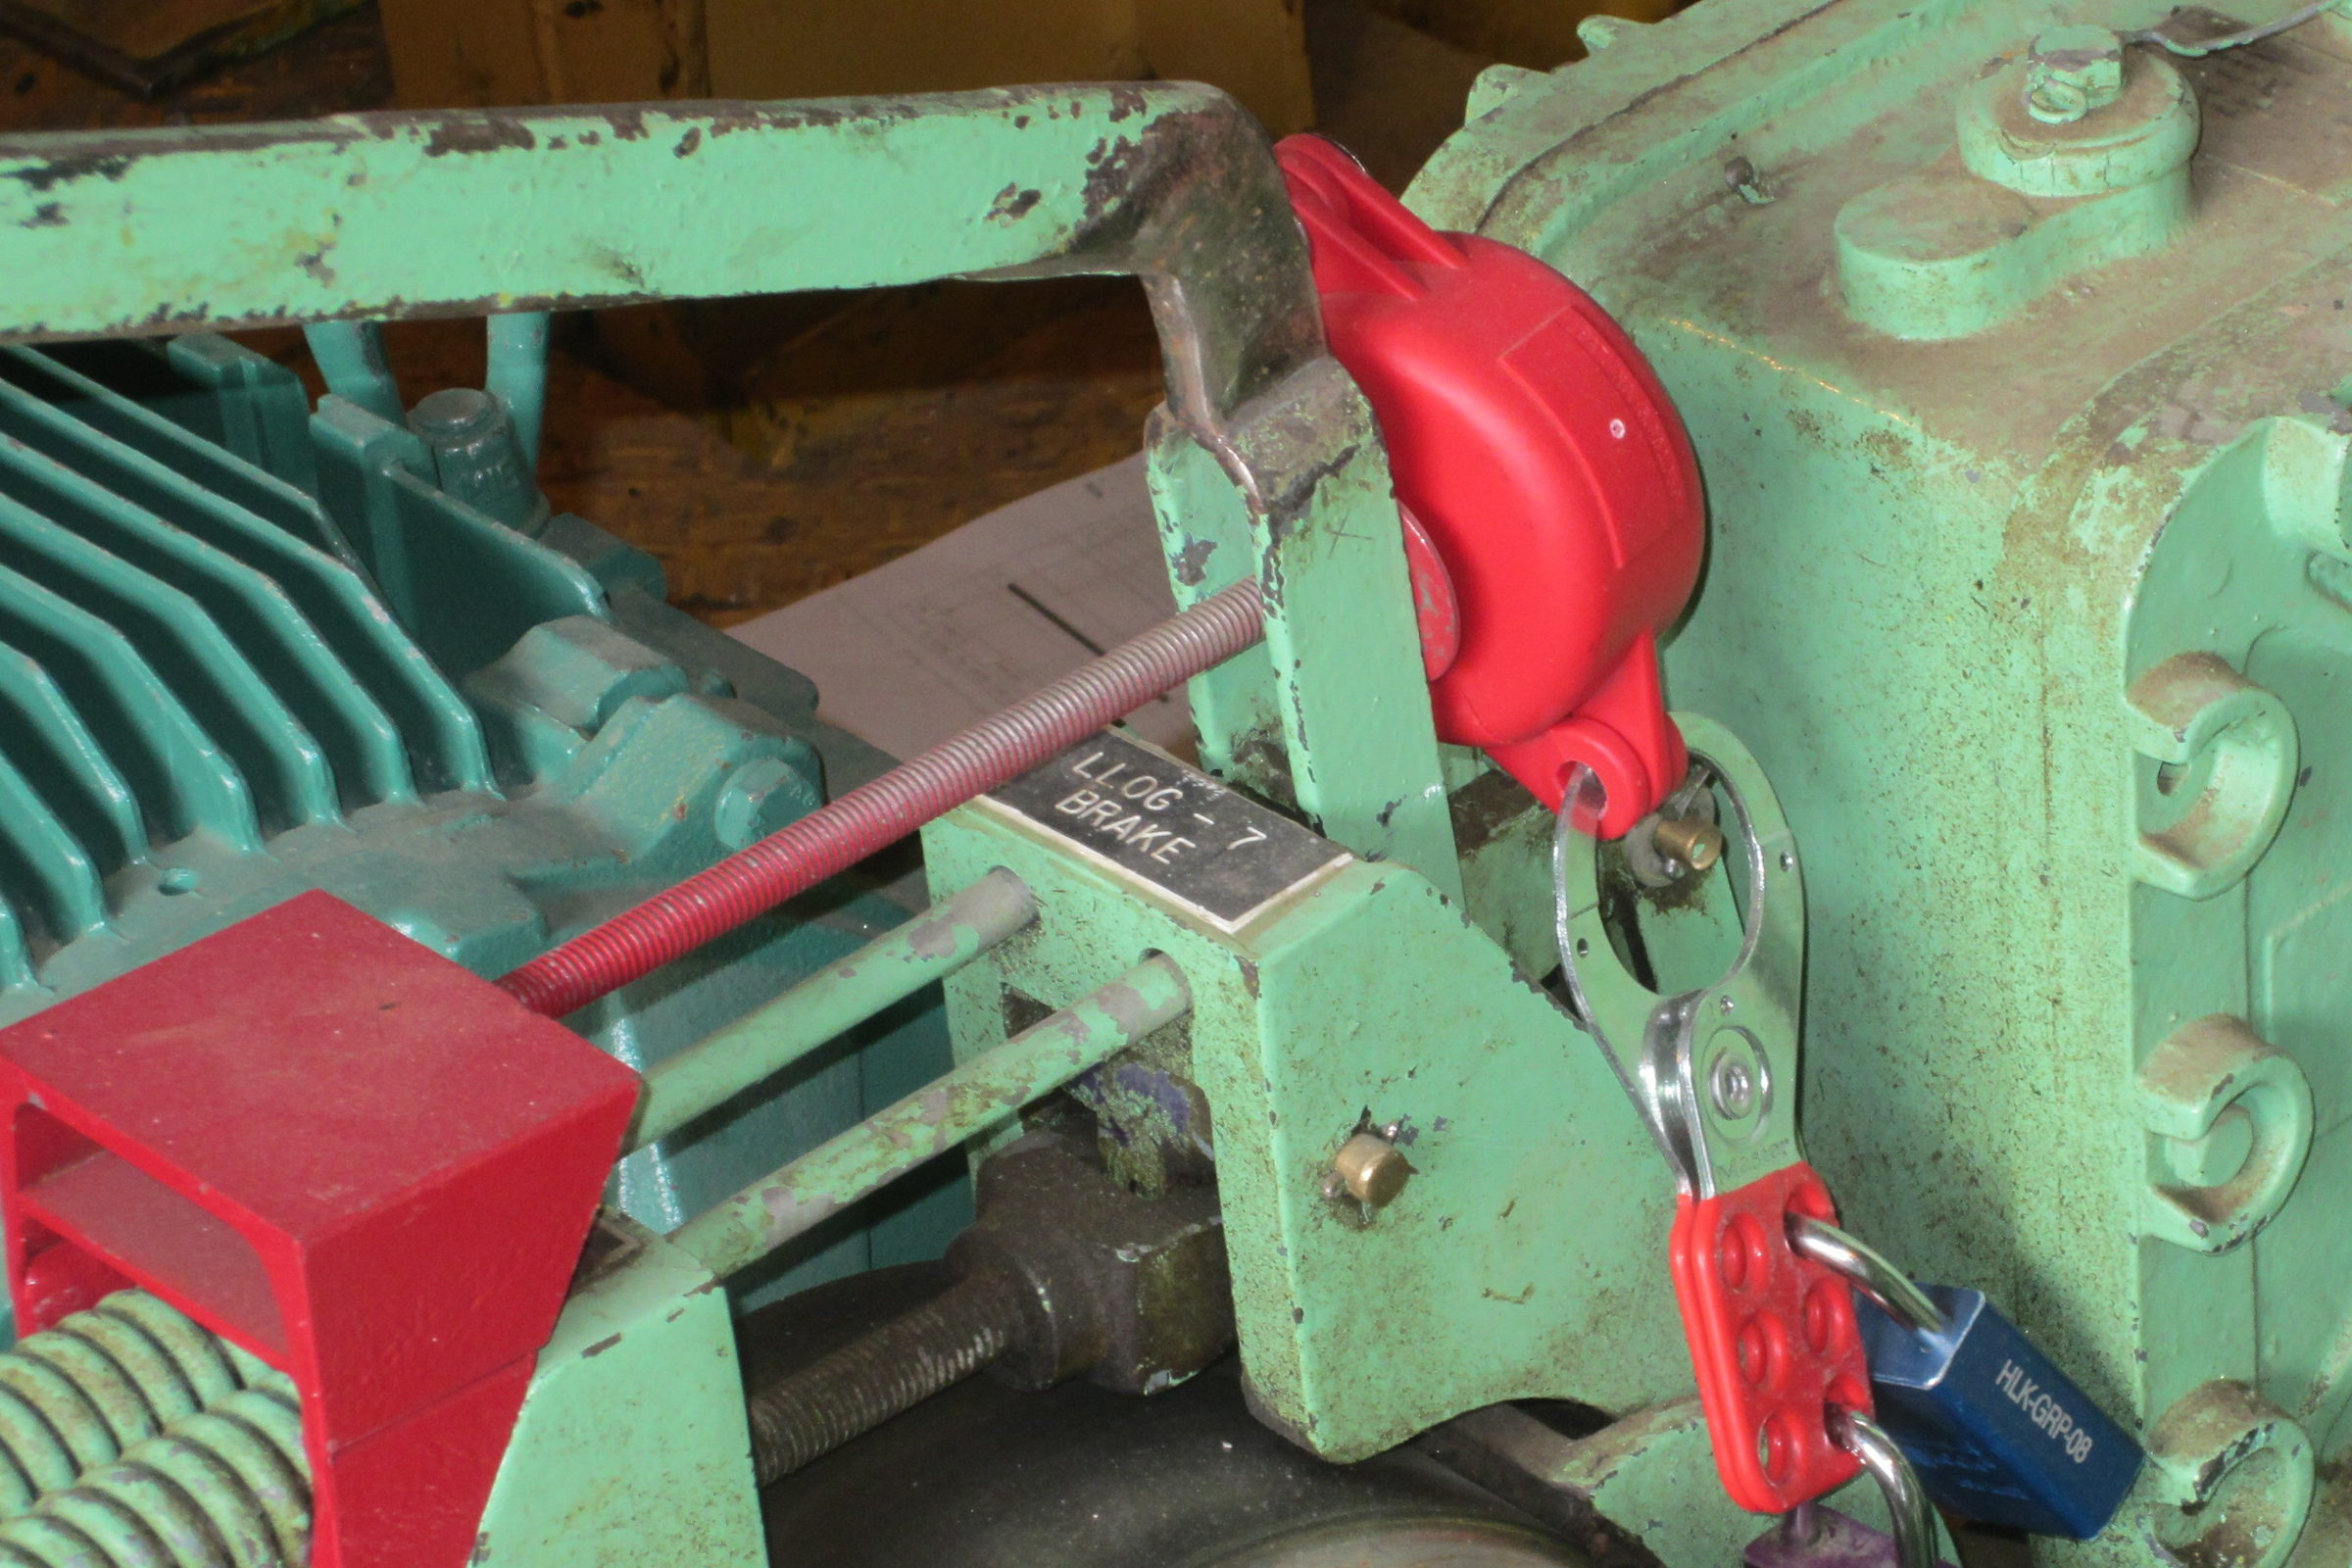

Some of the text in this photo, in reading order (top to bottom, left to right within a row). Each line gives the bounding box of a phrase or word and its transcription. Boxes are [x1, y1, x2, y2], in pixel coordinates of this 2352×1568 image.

[1055, 789, 1196, 864] BRAKE
[1227, 826, 1267, 850] 7
[1995, 1359, 2092, 1463] HLK-GRP-08
